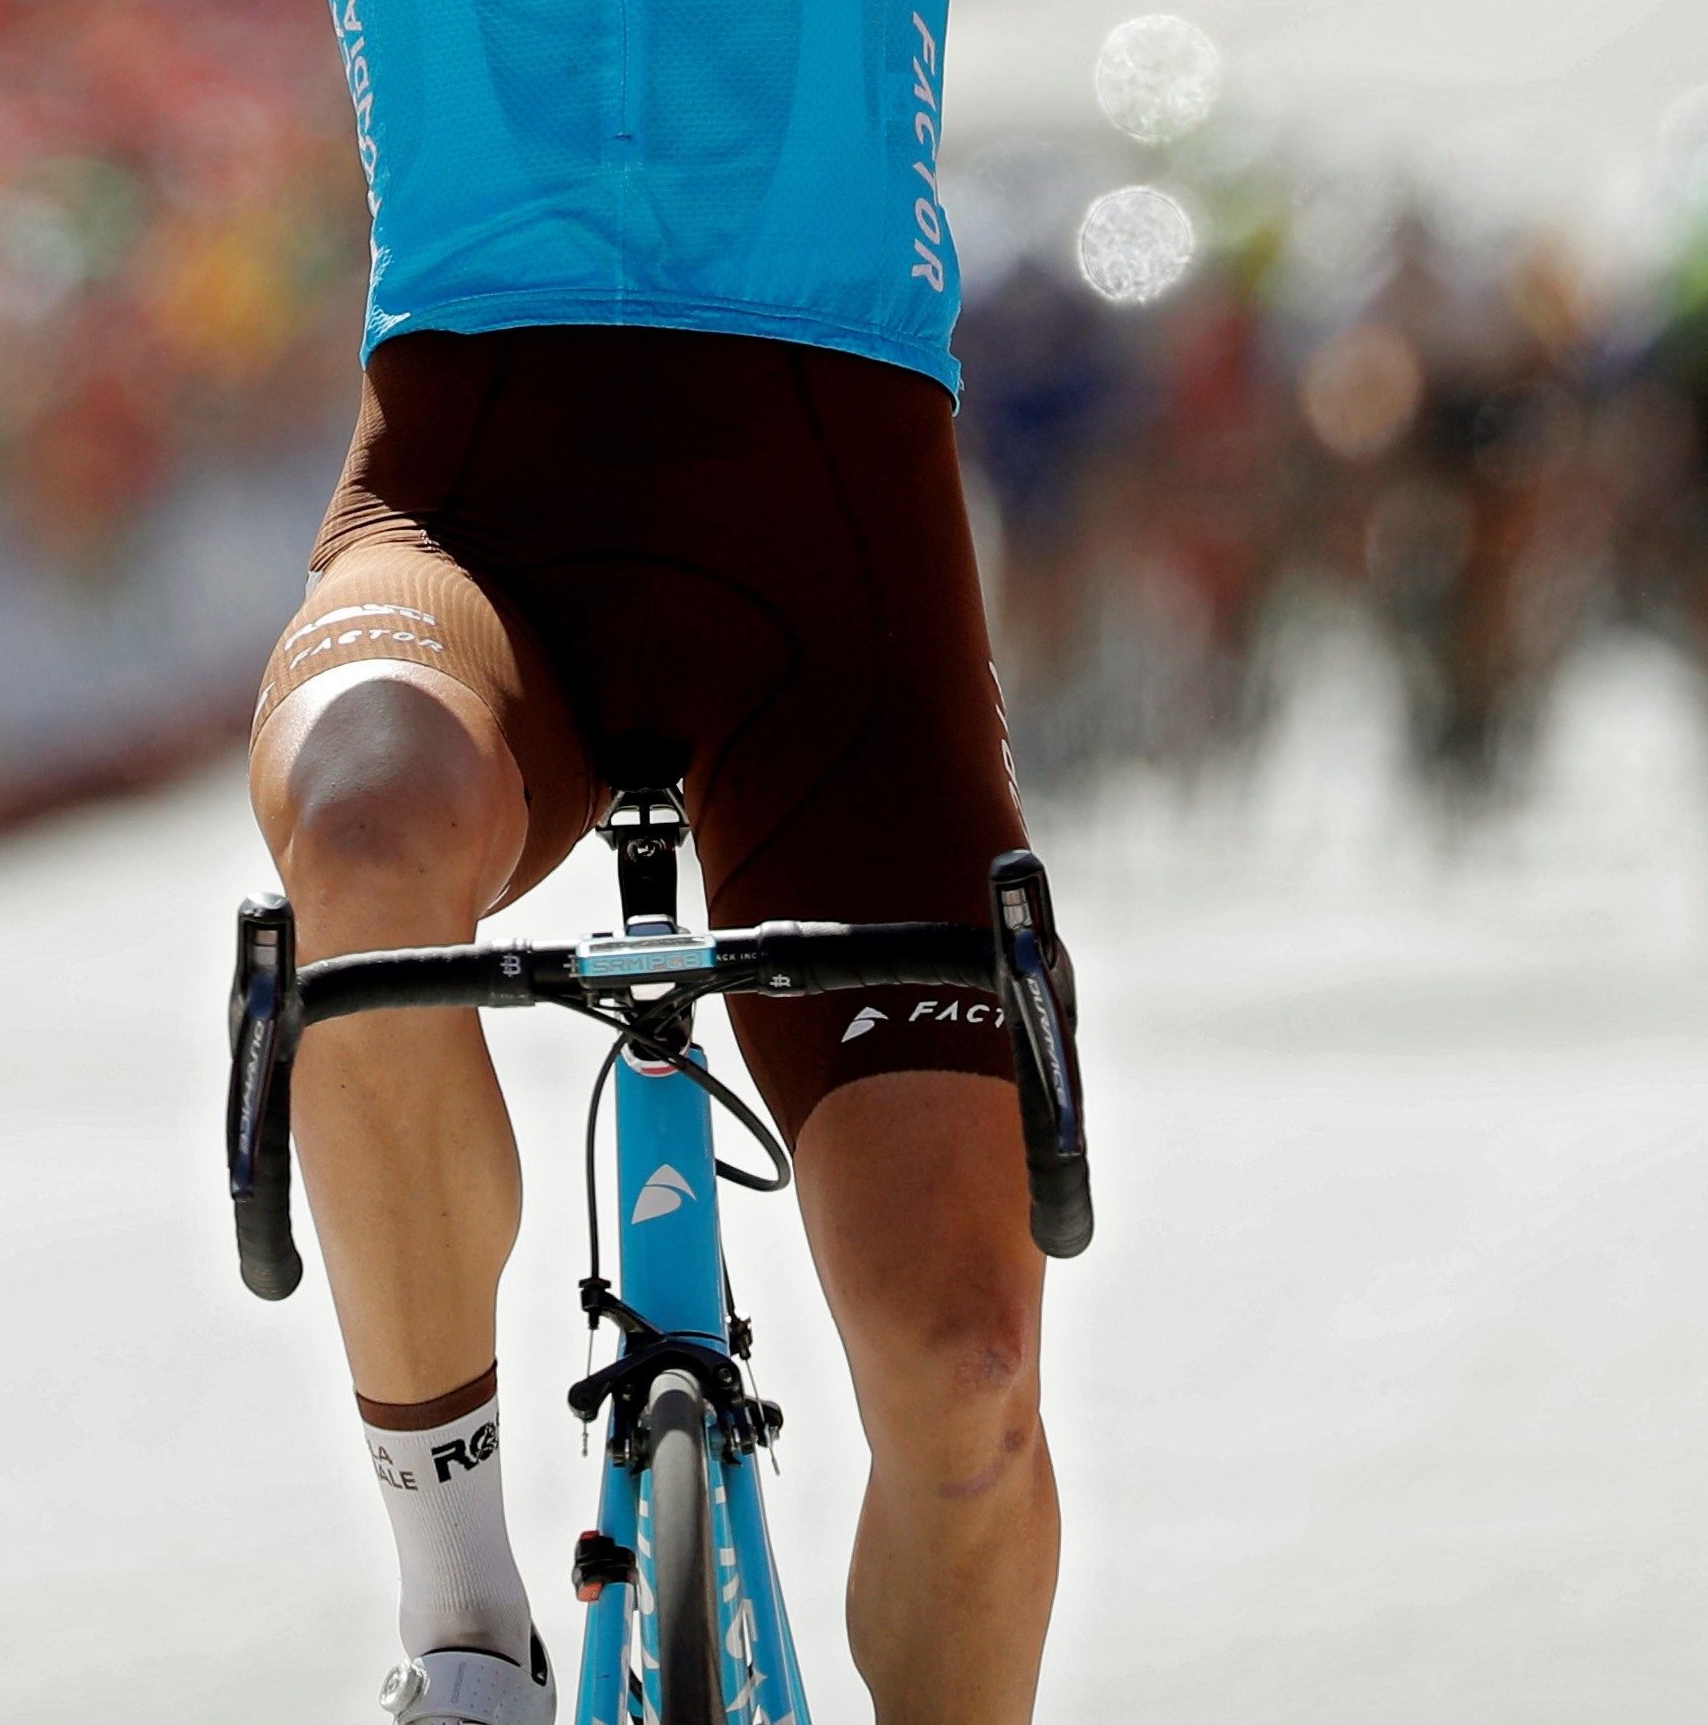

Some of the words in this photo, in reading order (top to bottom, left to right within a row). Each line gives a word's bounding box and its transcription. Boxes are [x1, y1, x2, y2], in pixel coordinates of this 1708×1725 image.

[912, 11, 945, 293] FACTOR
[908, 1001, 1005, 1029] FACT
[430, 1413, 499, 1485] RO
